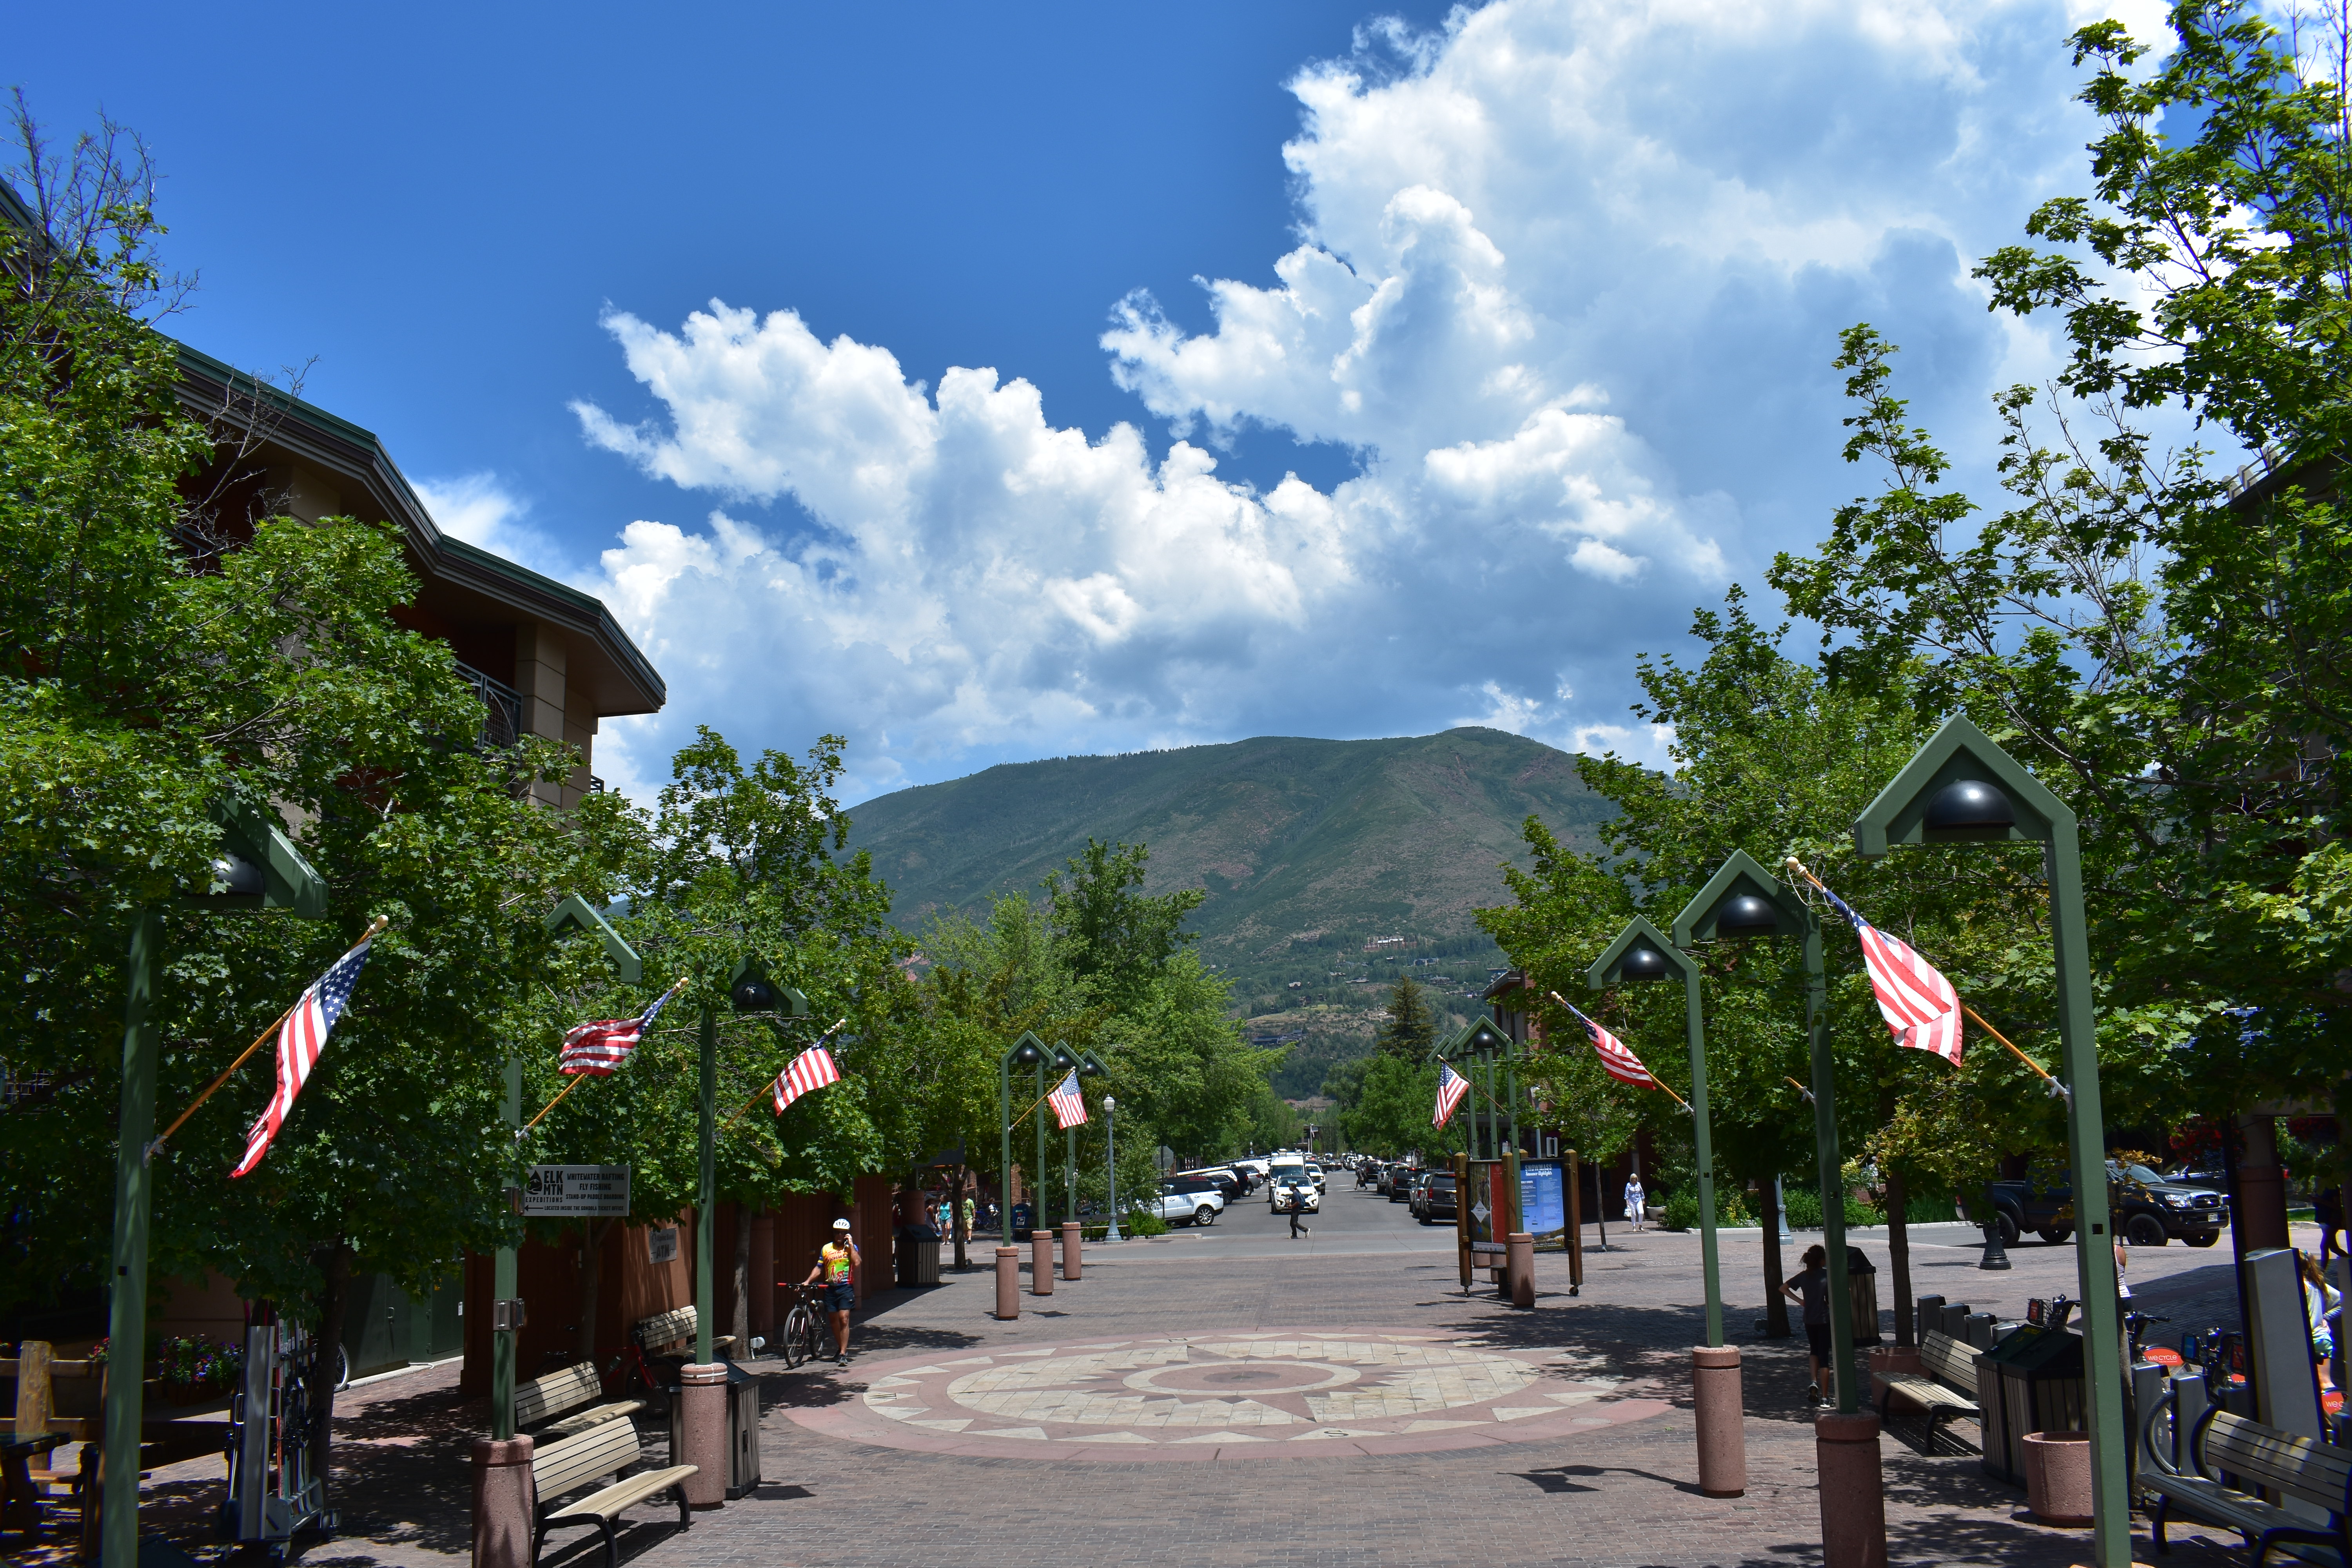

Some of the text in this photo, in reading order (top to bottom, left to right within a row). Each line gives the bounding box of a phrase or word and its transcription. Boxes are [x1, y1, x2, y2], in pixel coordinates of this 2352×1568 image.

[544, 1171, 564, 1183] ELK
[543, 1184, 563, 1195] MTN
[656, 1244, 670, 1259] ATM
